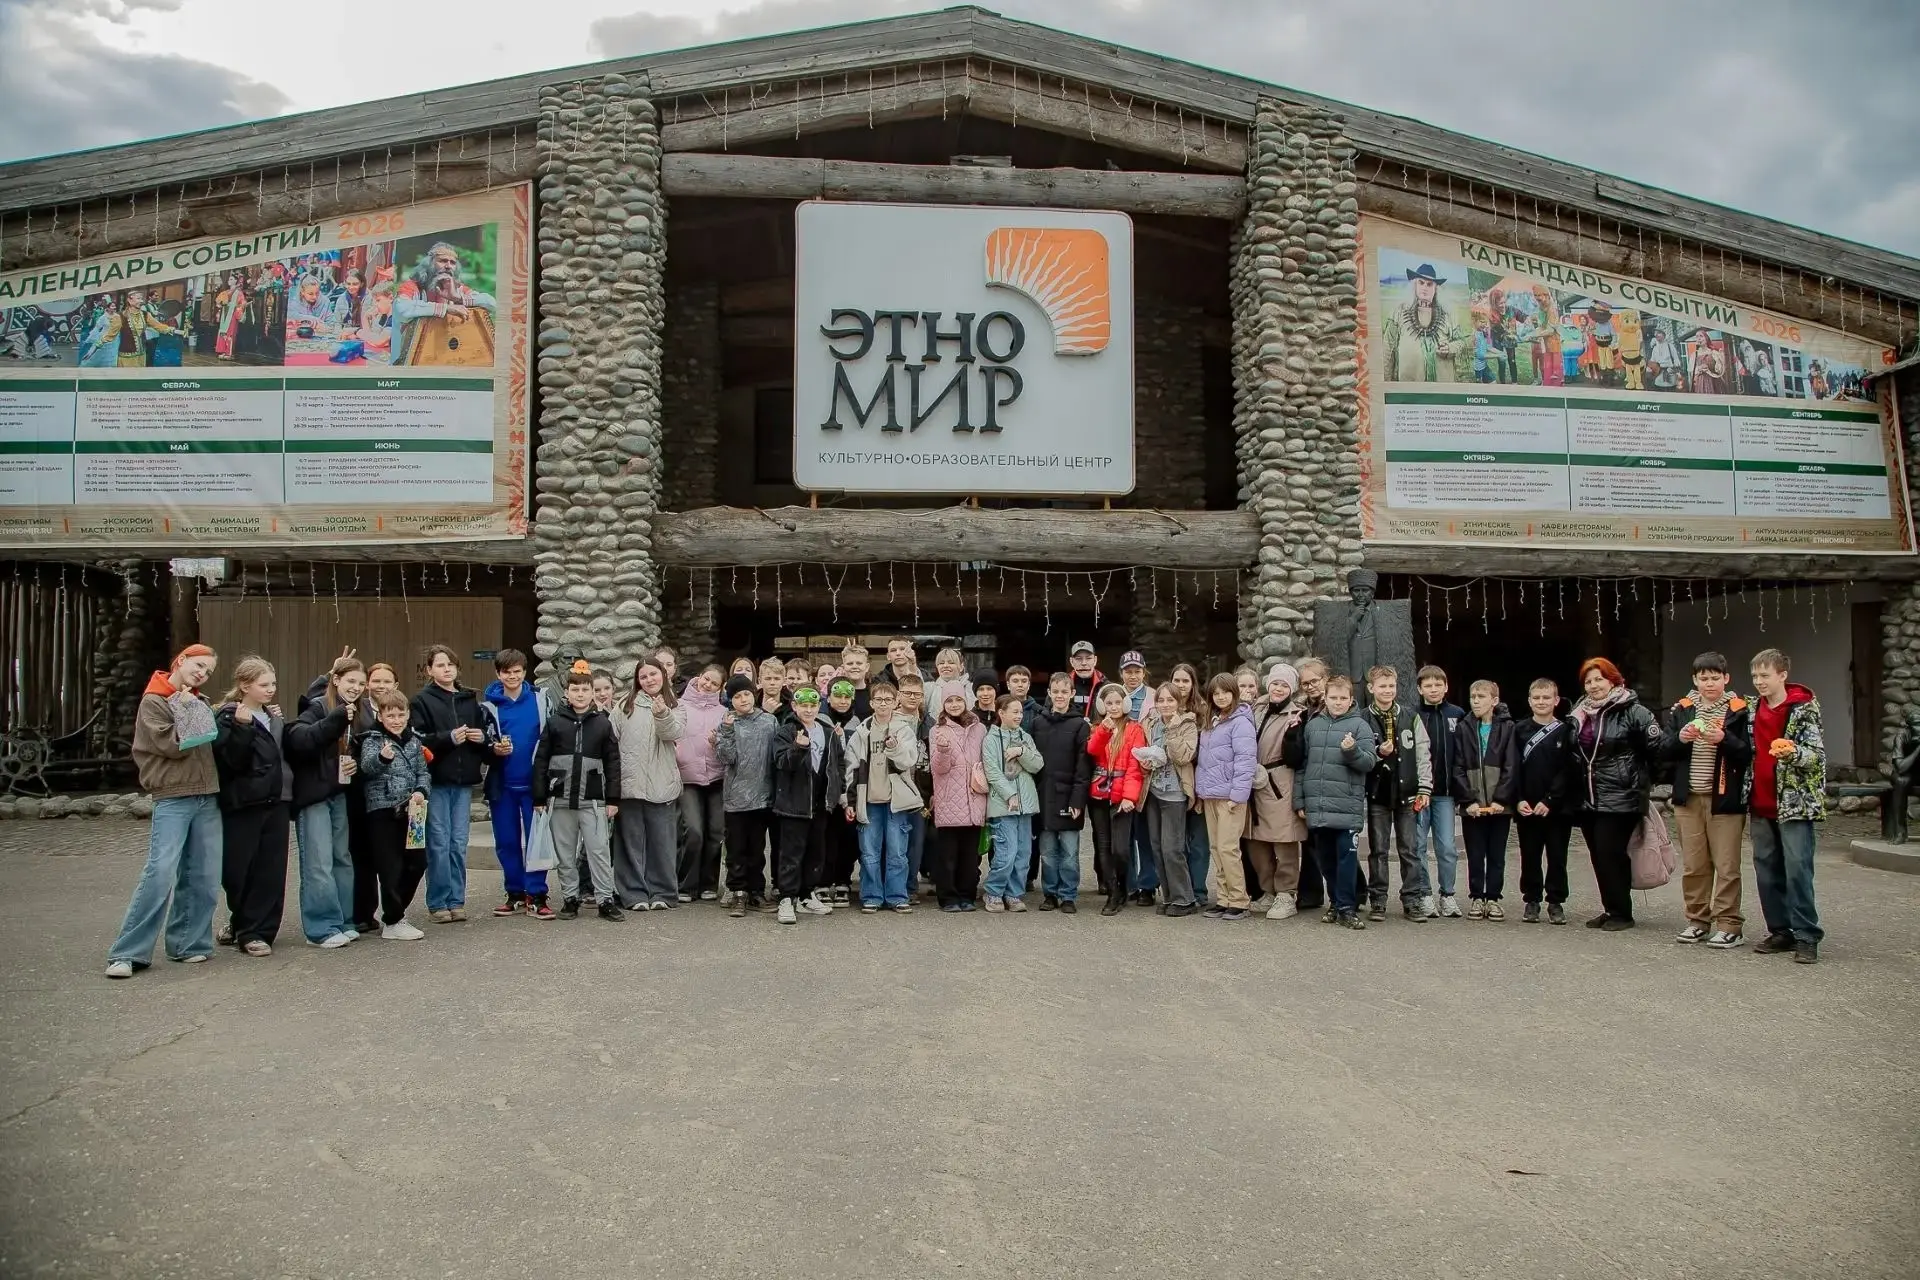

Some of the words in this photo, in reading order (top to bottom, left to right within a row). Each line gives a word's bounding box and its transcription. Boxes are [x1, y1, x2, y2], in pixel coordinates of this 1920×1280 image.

[0, 258, 164, 298] АЛЕНДАРЬ
[338, 211, 405, 240] 2026
[1460, 241, 1613, 295] КАЛЕНДАРЬ
[1619, 283, 1739, 327] СОБЫТИЙ
[1750, 315, 1802, 343] 2026
[820, 308, 1026, 363] ЭТНО
[161, 381, 201, 390] ФЕВРАЛЬ
[377, 380, 400, 388] МАРТ
[820, 361, 1024, 433] МИР
[1791, 411, 1823, 419] СЕНТЯБРЬ
[170, 442, 189, 451] МАЙ
[1064, 456, 1113, 470] ЦЕНТР
[4, 518, 52, 526] СОБЫТИЯМ
[103, 517, 153, 525] ЭКСКУРСИИ
[211, 517, 260, 525] АНИМАЦИЯ
[326, 516, 367, 524] ЗООДОМА
[396, 515, 462, 523] ТЕМАТИЧЕСКИЕ
[81, 526, 154, 534] МАСТЕР-КЛАССЫ
[289, 524, 336, 533] АКТИВНЫЙ
[338, 525, 368, 533] ОТДЫХ
[1569, 523, 1612, 531] РЕСТОРАНЫ
[1693, 535, 1735, 543] ПРОДУКЦИИ
[1401, 729, 1414, 749] C
